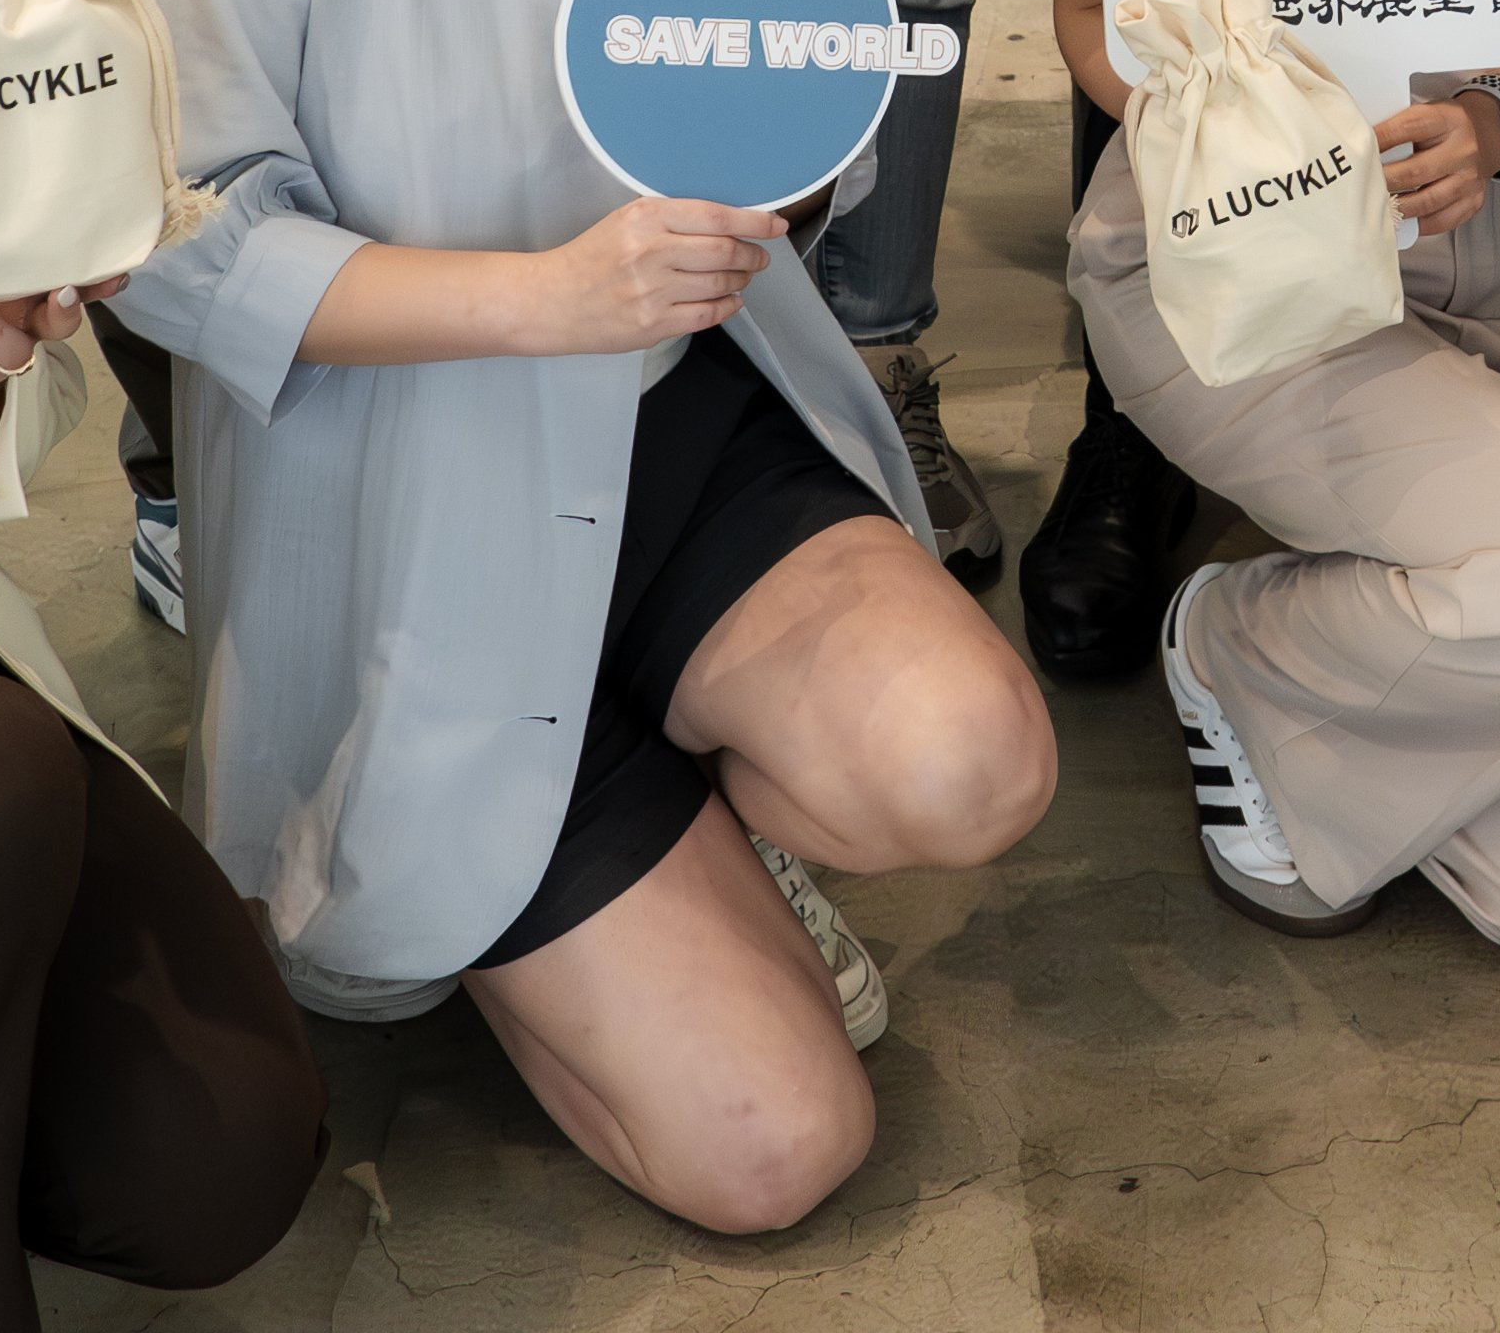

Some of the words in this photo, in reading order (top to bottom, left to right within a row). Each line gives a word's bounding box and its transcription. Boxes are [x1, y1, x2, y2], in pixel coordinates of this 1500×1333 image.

[605, 16, 750, 67] SAVE
[762, 20, 959, 73] WORLD
[1207, 143, 1353, 226] LUCYKLE
